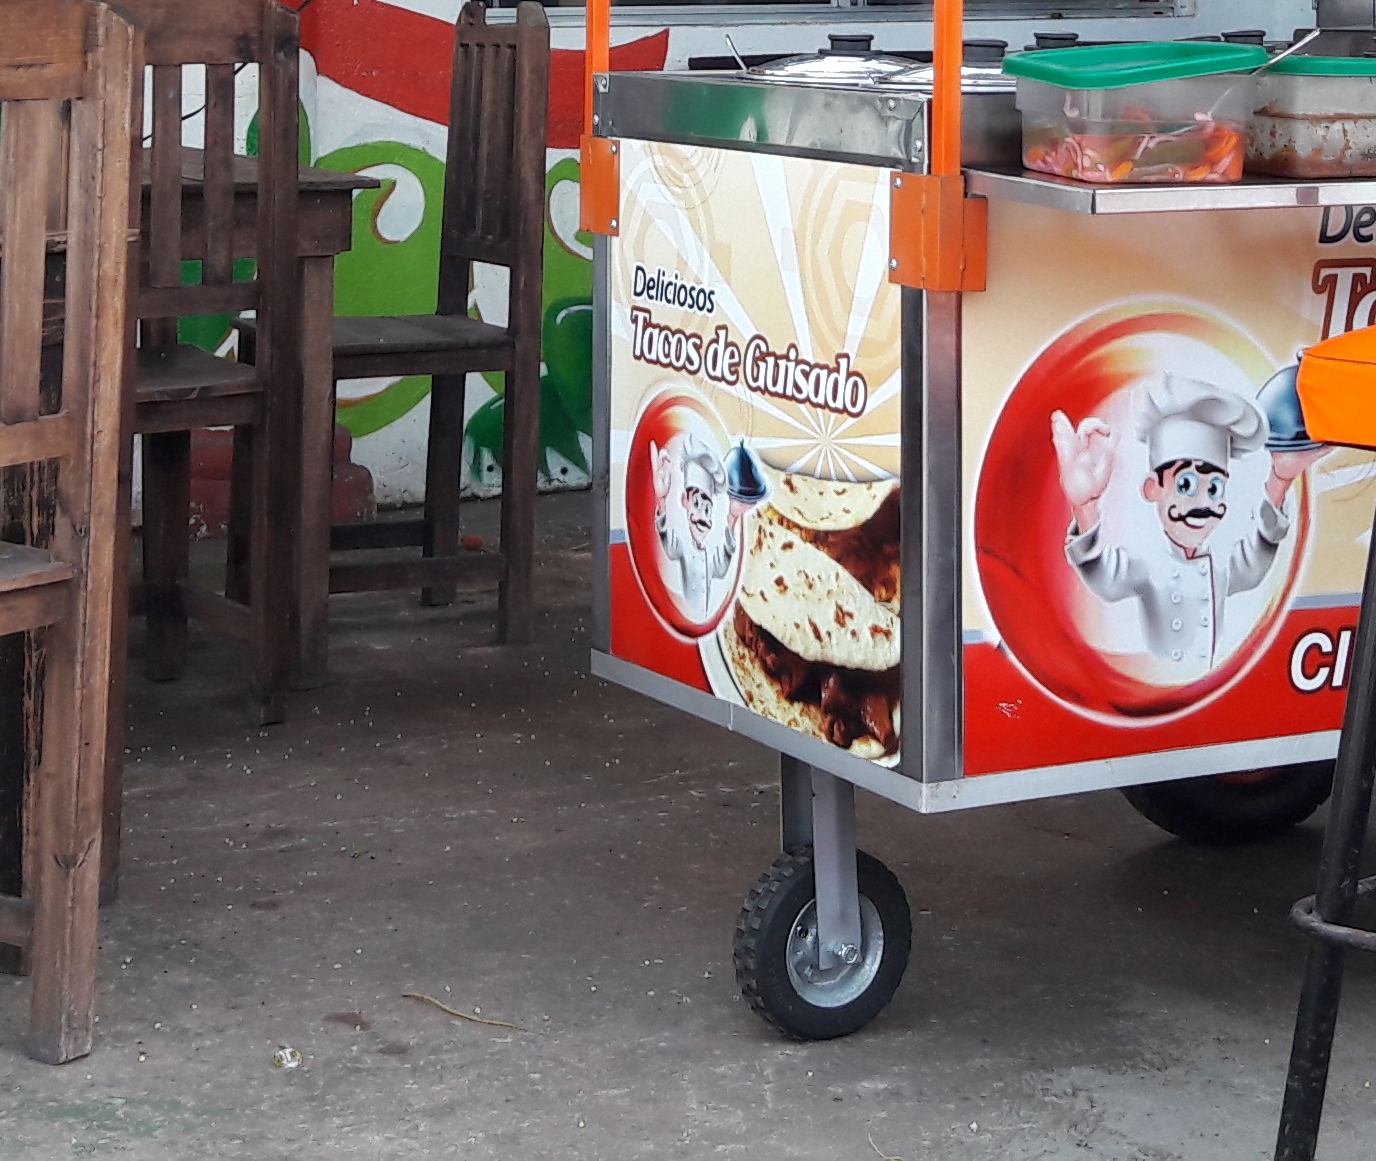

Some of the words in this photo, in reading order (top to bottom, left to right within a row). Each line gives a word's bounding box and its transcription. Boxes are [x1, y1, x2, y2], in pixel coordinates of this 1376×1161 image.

[633, 264, 716, 314] Deliciosos
[631, 306, 703, 375] Tacos
[705, 324, 741, 385] de
[744, 334, 867, 418] Guisado
